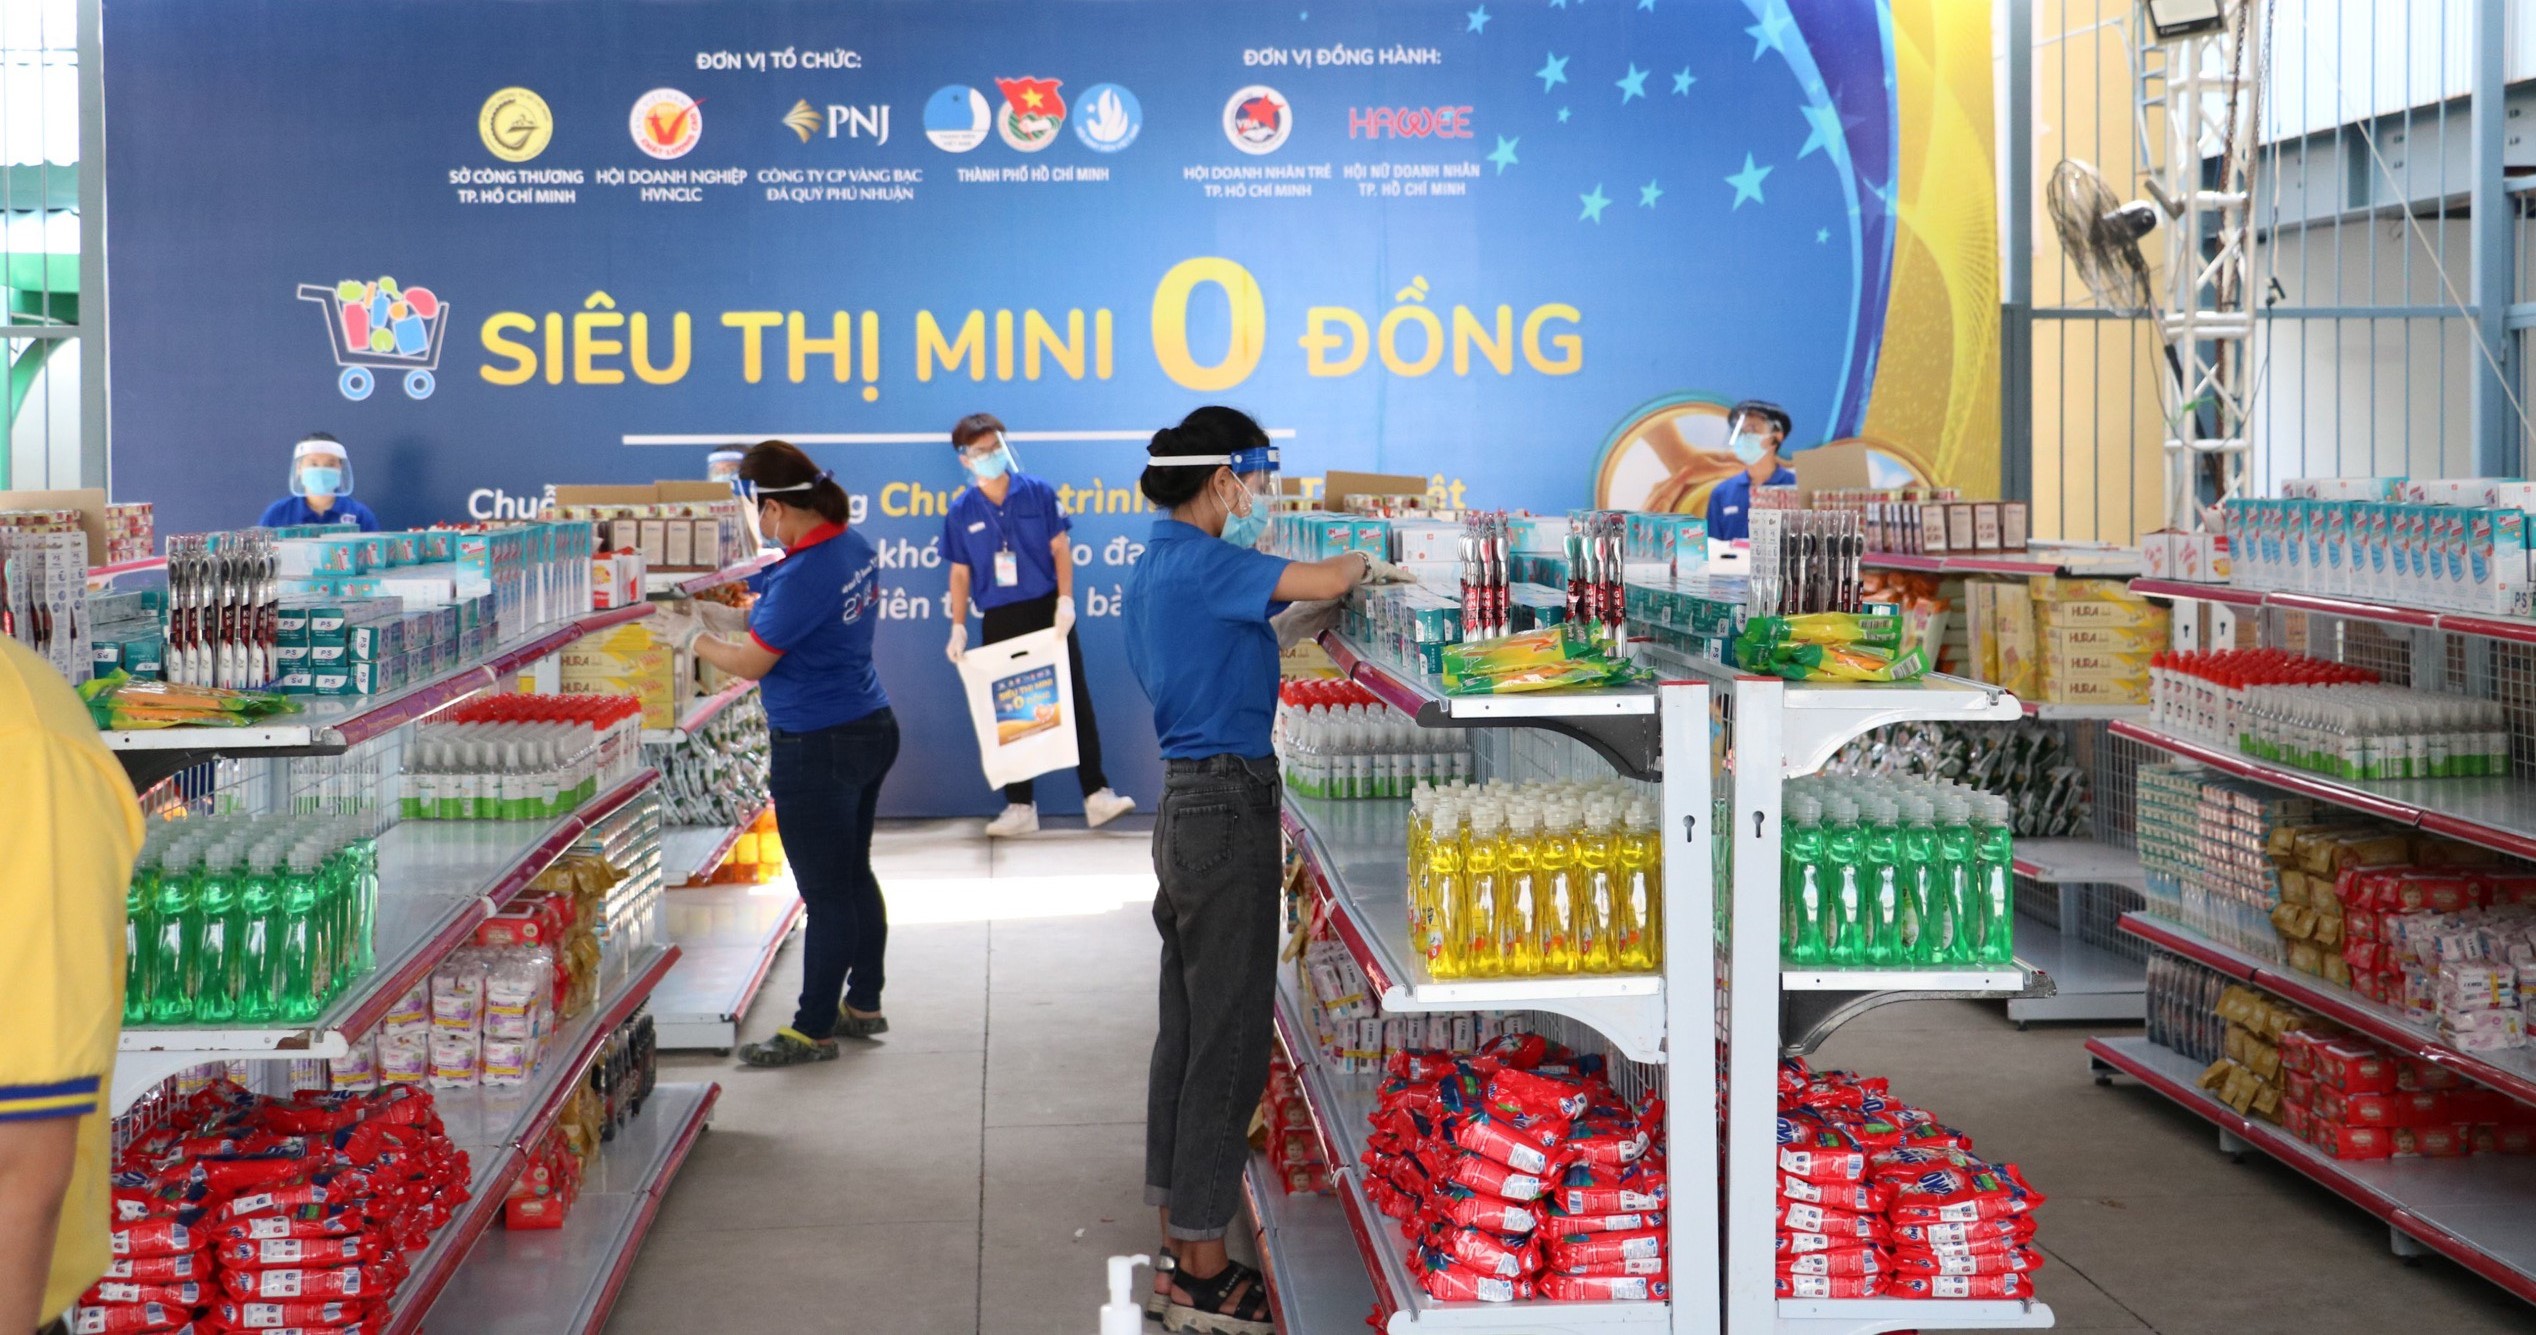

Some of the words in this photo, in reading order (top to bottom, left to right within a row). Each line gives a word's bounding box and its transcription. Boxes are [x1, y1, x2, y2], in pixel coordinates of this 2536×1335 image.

[695, 50, 742, 70] ĐƠN
[745, 52, 766, 73] VỊ
[770, 45, 798, 70] TỔ
[801, 47, 862, 70] CHỨC:
[1242, 47, 1288, 67] ĐƠN
[1291, 49, 1312, 69] VỊ
[1315, 42, 1375, 66] ĐỒNG
[1378, 45, 1442, 66] HÀNH:
[826, 104, 892, 147] PNJ
[1349, 106, 1474, 139] HAWEE
[449, 166, 472, 184] SỞ
[473, 167, 517, 184] CÔNG
[518, 168, 585, 185] THƯƠNG
[595, 167, 625, 186] HỘI
[628, 169, 687, 185] DOANH
[690, 167, 748, 186] NGHIỆP
[757, 167, 804, 183] CÔNG
[807, 169, 825, 183] TY
[826, 169, 847, 183] CP
[848, 167, 891, 183] VÀNG
[893, 169, 923, 185] BẠC
[957, 166, 1000, 182] THÀNH
[1002, 165, 1029, 182] PHỐ
[1052, 166, 1074, 181] CHÍ
[1076, 167, 1110, 181] MINH
[1183, 166, 1209, 180] HỘI
[1212, 167, 1263, 180] DOANH
[1343, 164, 1367, 179] HỘI
[1393, 164, 1440, 178] DOANH
[457, 189, 479, 203] TP.
[505, 188, 533, 204] CHÍ
[535, 189, 576, 204] MINH
[640, 187, 703, 202] HVNCLC
[766, 187, 789, 201] ĐÁ
[1204, 185, 1223, 196] TP.
[1249, 184, 1272, 197] CHÍ
[1274, 184, 1312, 196] MINH
[1358, 183, 1378, 195] TP.
[1404, 183, 1427, 195] CHÍ
[1430, 183, 1466, 195] MINH
[480, 291, 691, 385] SIÊU
[721, 311, 879, 402] THỊ
[916, 308, 1113, 382] MINI
[1151, 257, 1266, 392] 0
[1297, 275, 1583, 377] ĐỒNG
[2514, 591, 2528, 609] PS
[2071, 606, 2099, 617] HURA
[2068, 632, 2097, 643] HURA
[2071, 658, 2099, 668] HURA
[2069, 683, 2097, 694] HURA
[1918, 1171, 1954, 1196] OMO
